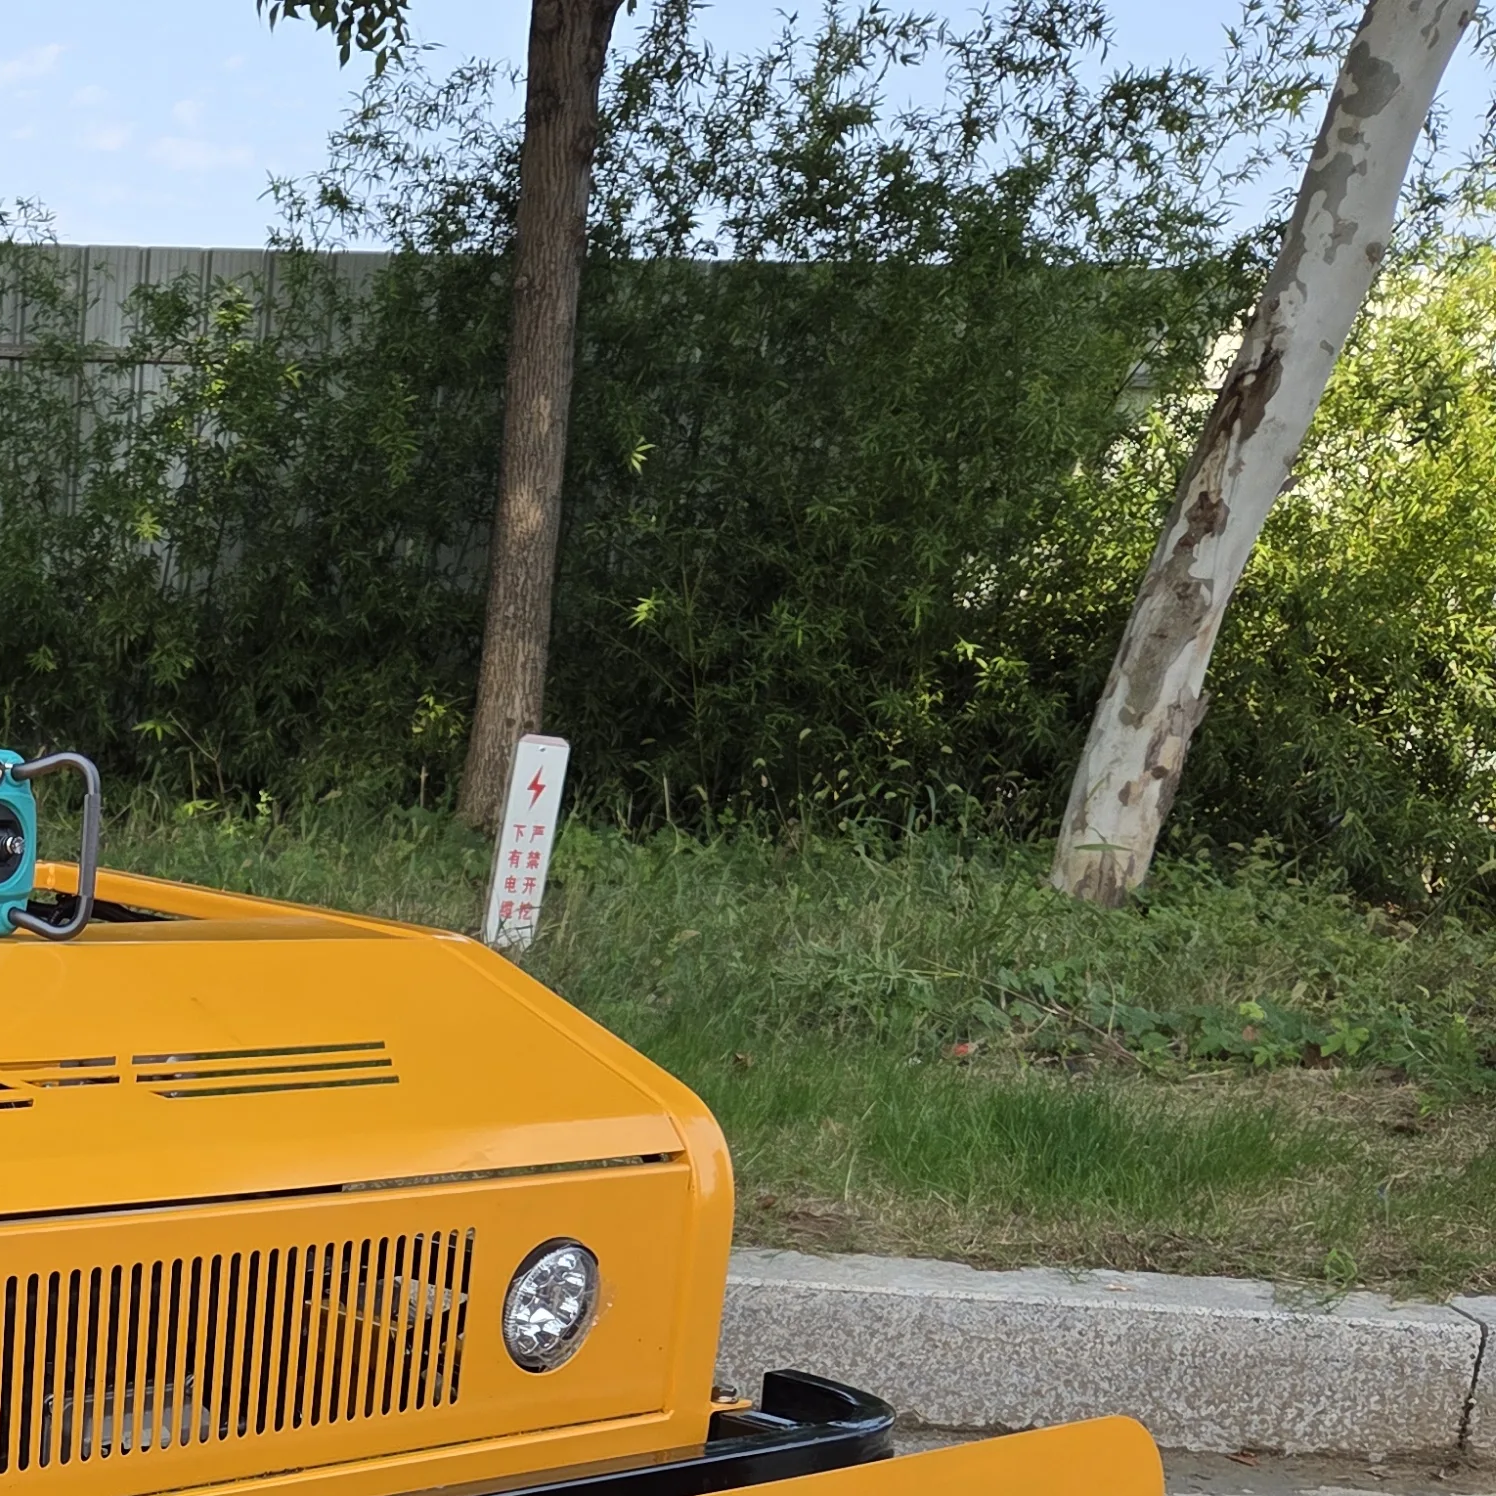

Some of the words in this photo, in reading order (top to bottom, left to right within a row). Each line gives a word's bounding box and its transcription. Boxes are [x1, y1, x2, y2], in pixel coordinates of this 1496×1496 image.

[499, 824, 527, 919] 下有电缆
[518, 825, 546, 920] 严禁开挖
